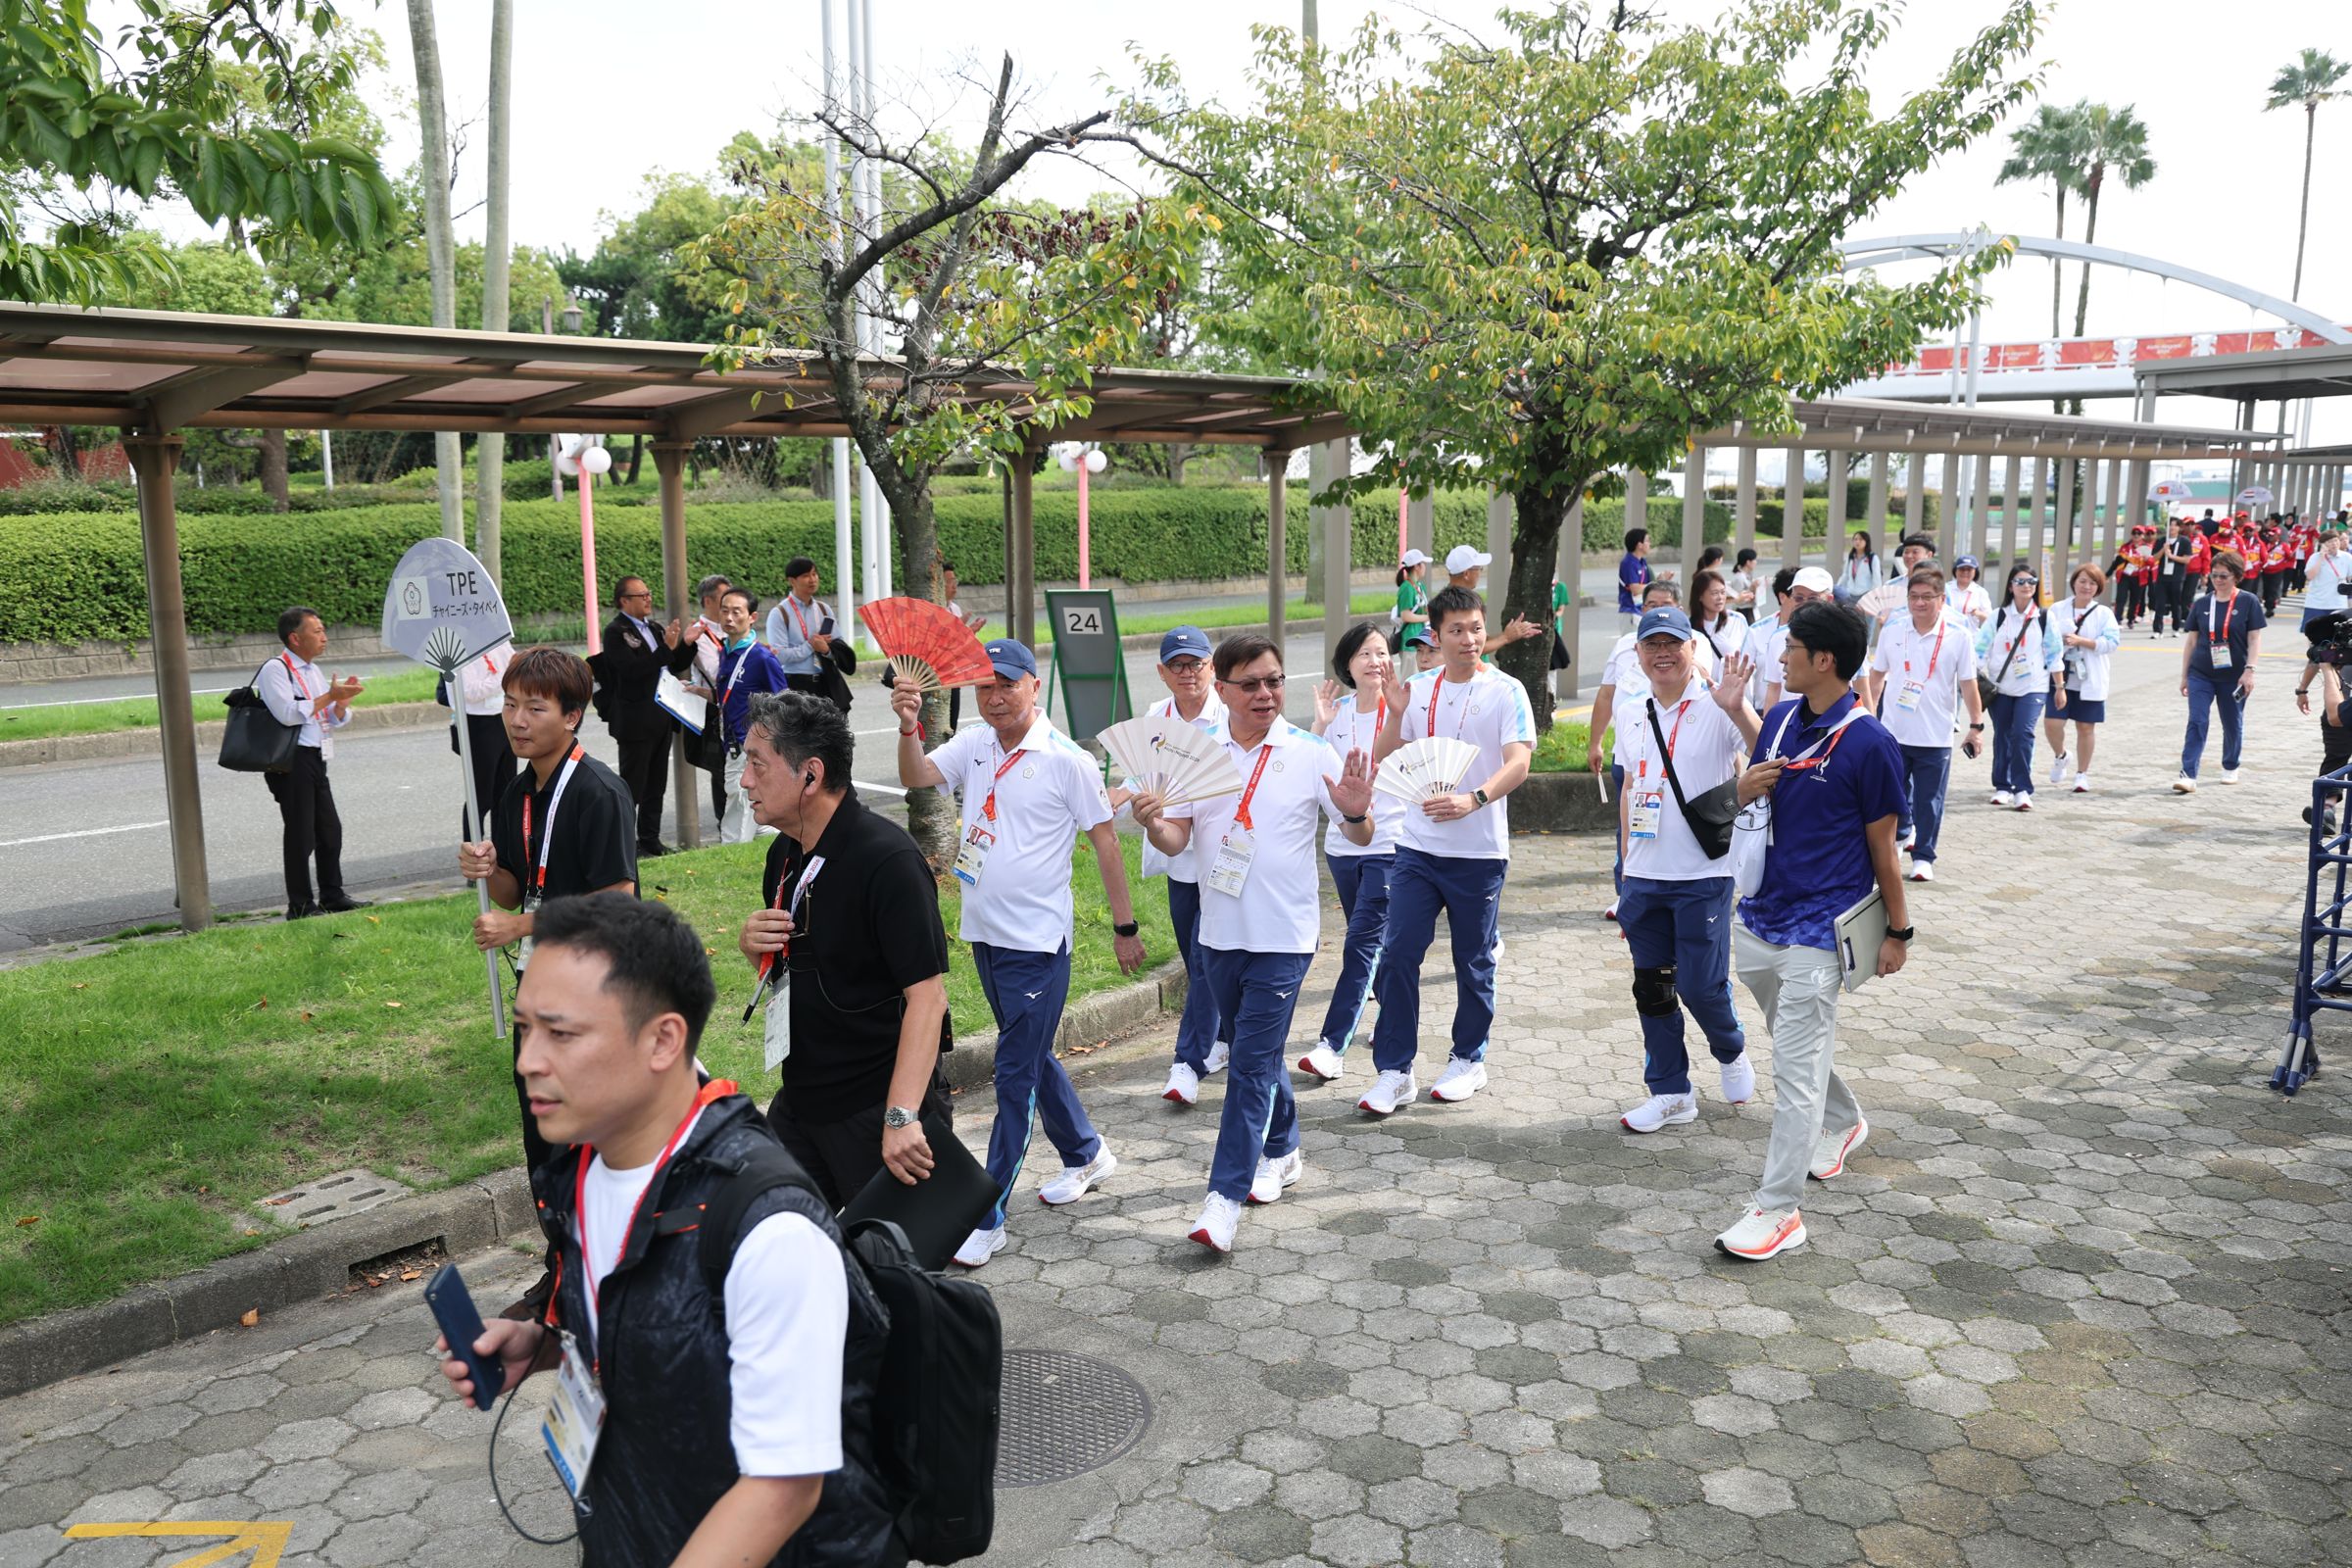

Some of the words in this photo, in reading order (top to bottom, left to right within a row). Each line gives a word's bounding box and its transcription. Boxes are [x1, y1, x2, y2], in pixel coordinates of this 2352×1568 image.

[446, 570, 478, 597] TPE
[432, 600, 498, 618] チャイニーズ・タイペイ
[1068, 613, 1100, 632] 24
[810, 859, 820, 871] 2026
